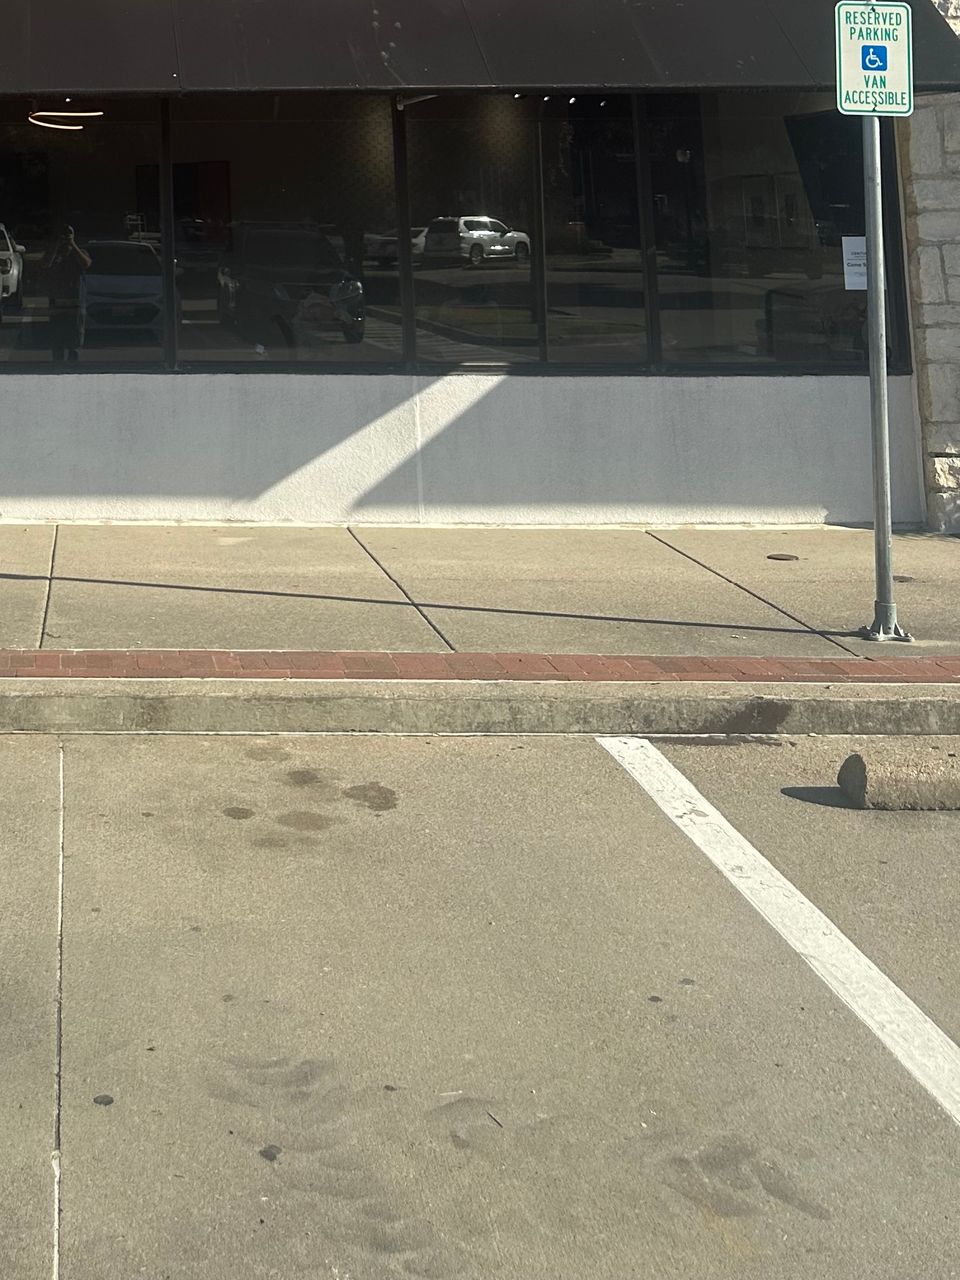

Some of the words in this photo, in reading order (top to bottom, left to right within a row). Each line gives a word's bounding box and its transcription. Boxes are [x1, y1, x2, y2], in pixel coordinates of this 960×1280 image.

[845, 11, 902, 26] RESERVED
[850, 27, 899, 42] PARKING
[864, 75, 886, 89] VAN
[844, 90, 907, 106] ACCESSIBLE
